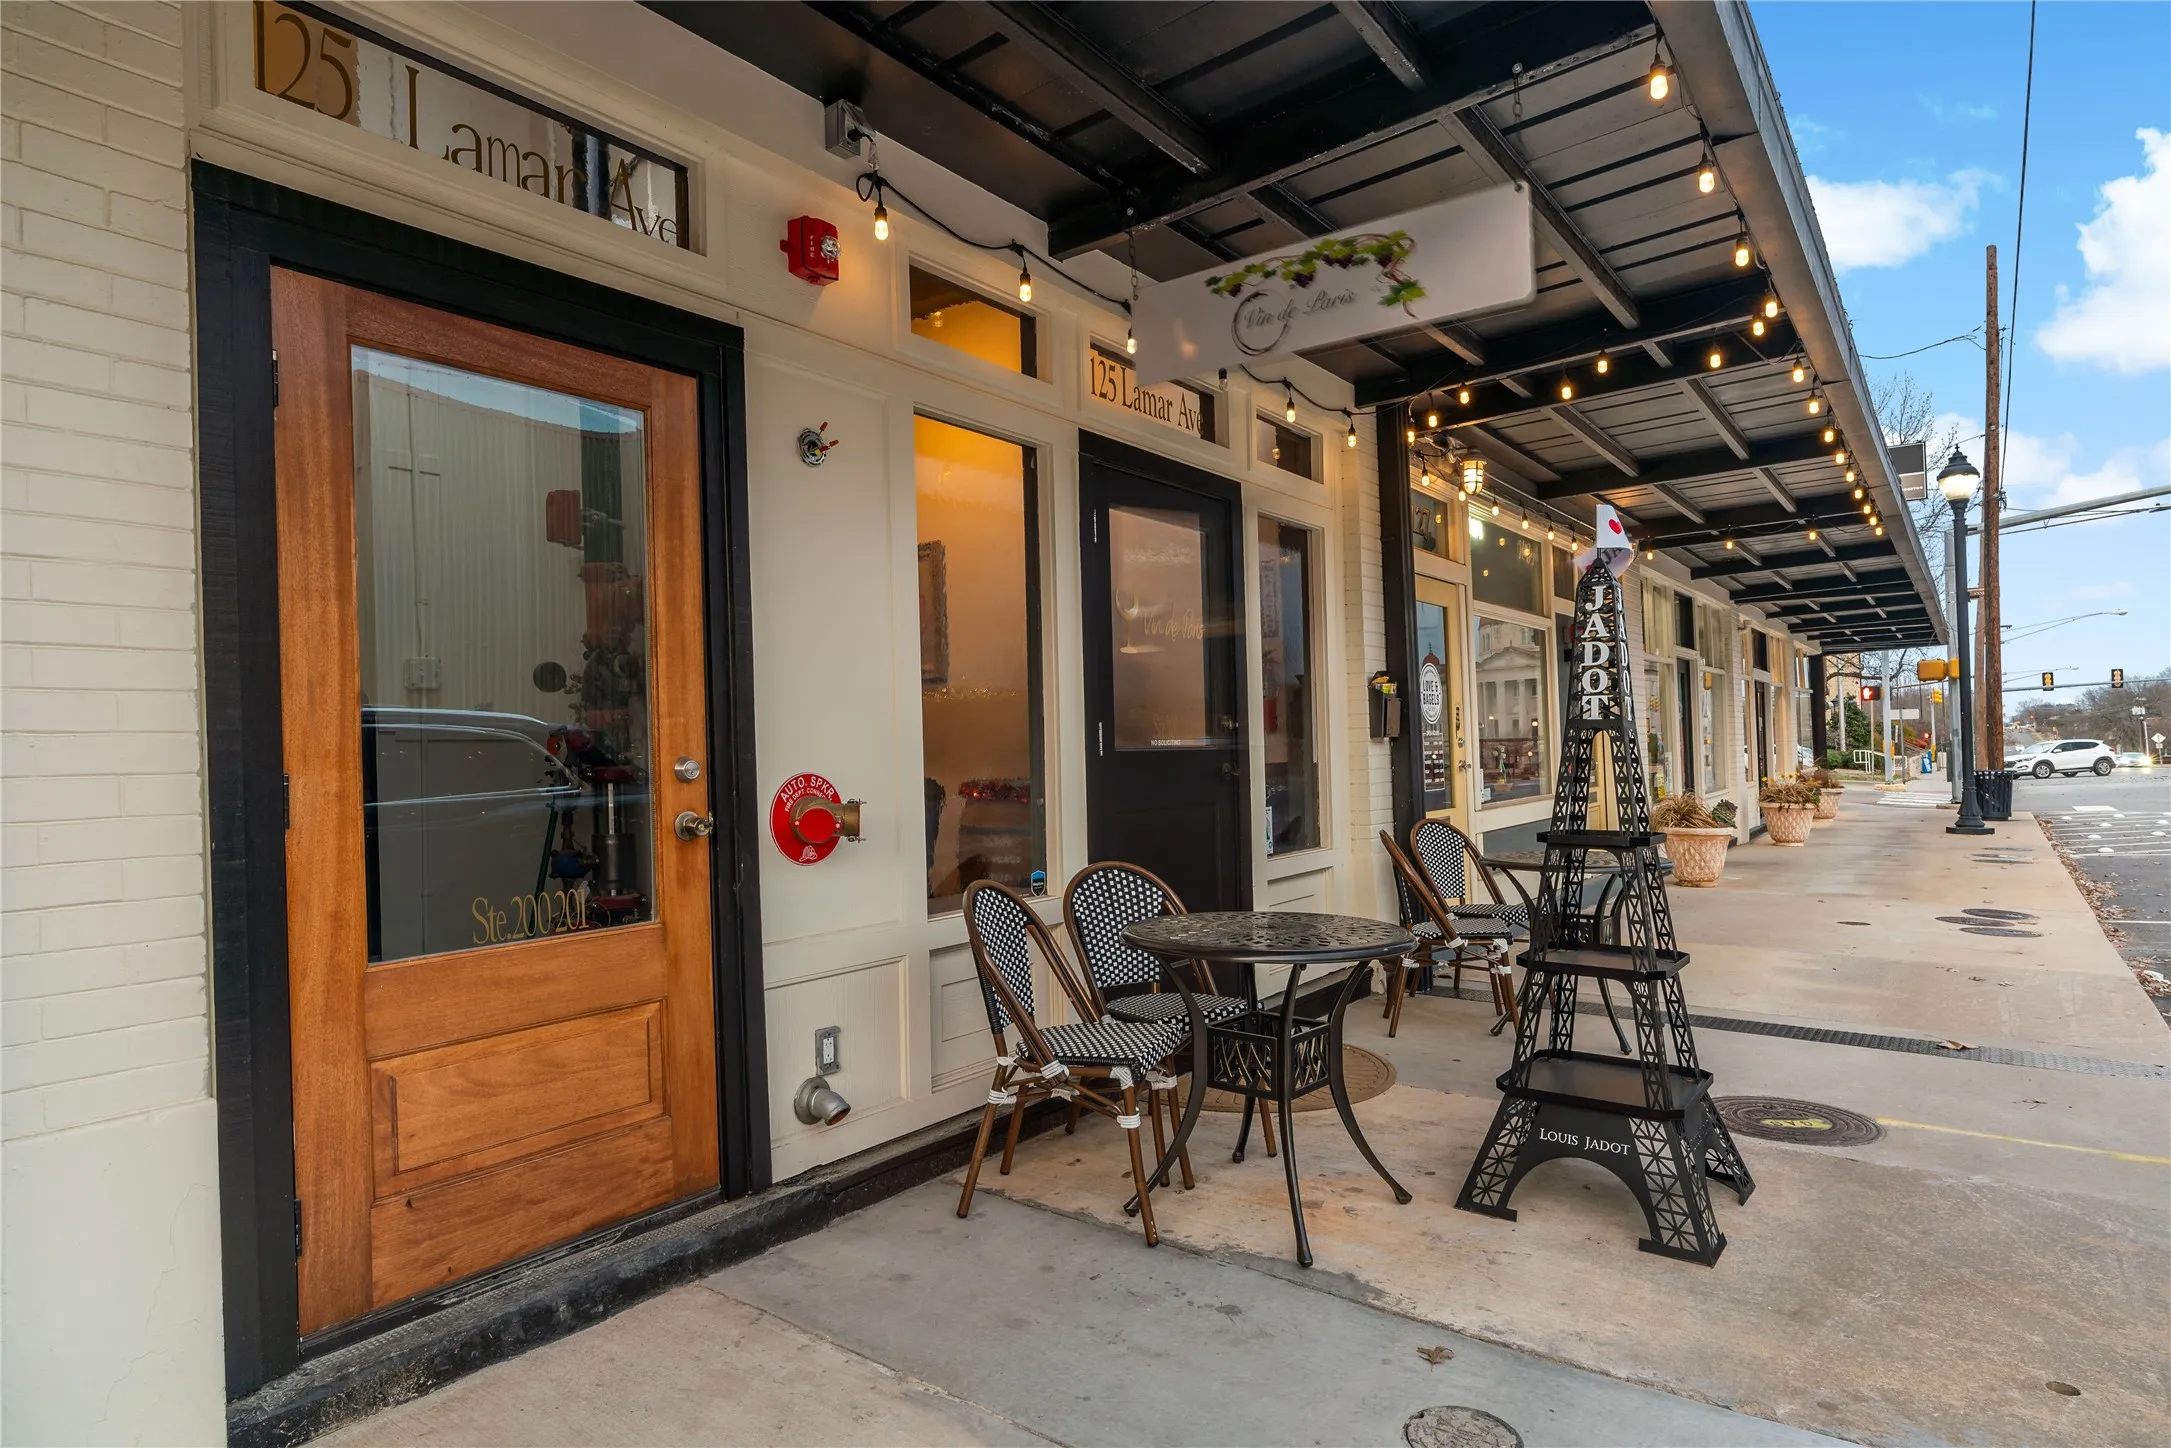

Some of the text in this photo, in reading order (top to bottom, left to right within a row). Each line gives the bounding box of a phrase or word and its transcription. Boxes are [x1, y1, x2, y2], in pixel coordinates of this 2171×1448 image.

[253, 0, 681, 246] 125 Lamar Ave
[1243, 289, 1358, 329] Vin de Paris
[1090, 356, 1204, 436] 125 Lamar Ave
[1581, 585, 1611, 720] JADOT
[1616, 587, 1634, 721] JADOT
[1422, 680, 1433, 692] LOVE
[1423, 693, 1440, 705] BAGELS
[781, 776, 835, 802] AUTO. SPKR.
[1539, 1127, 1631, 1155] LOUIS JADOT
